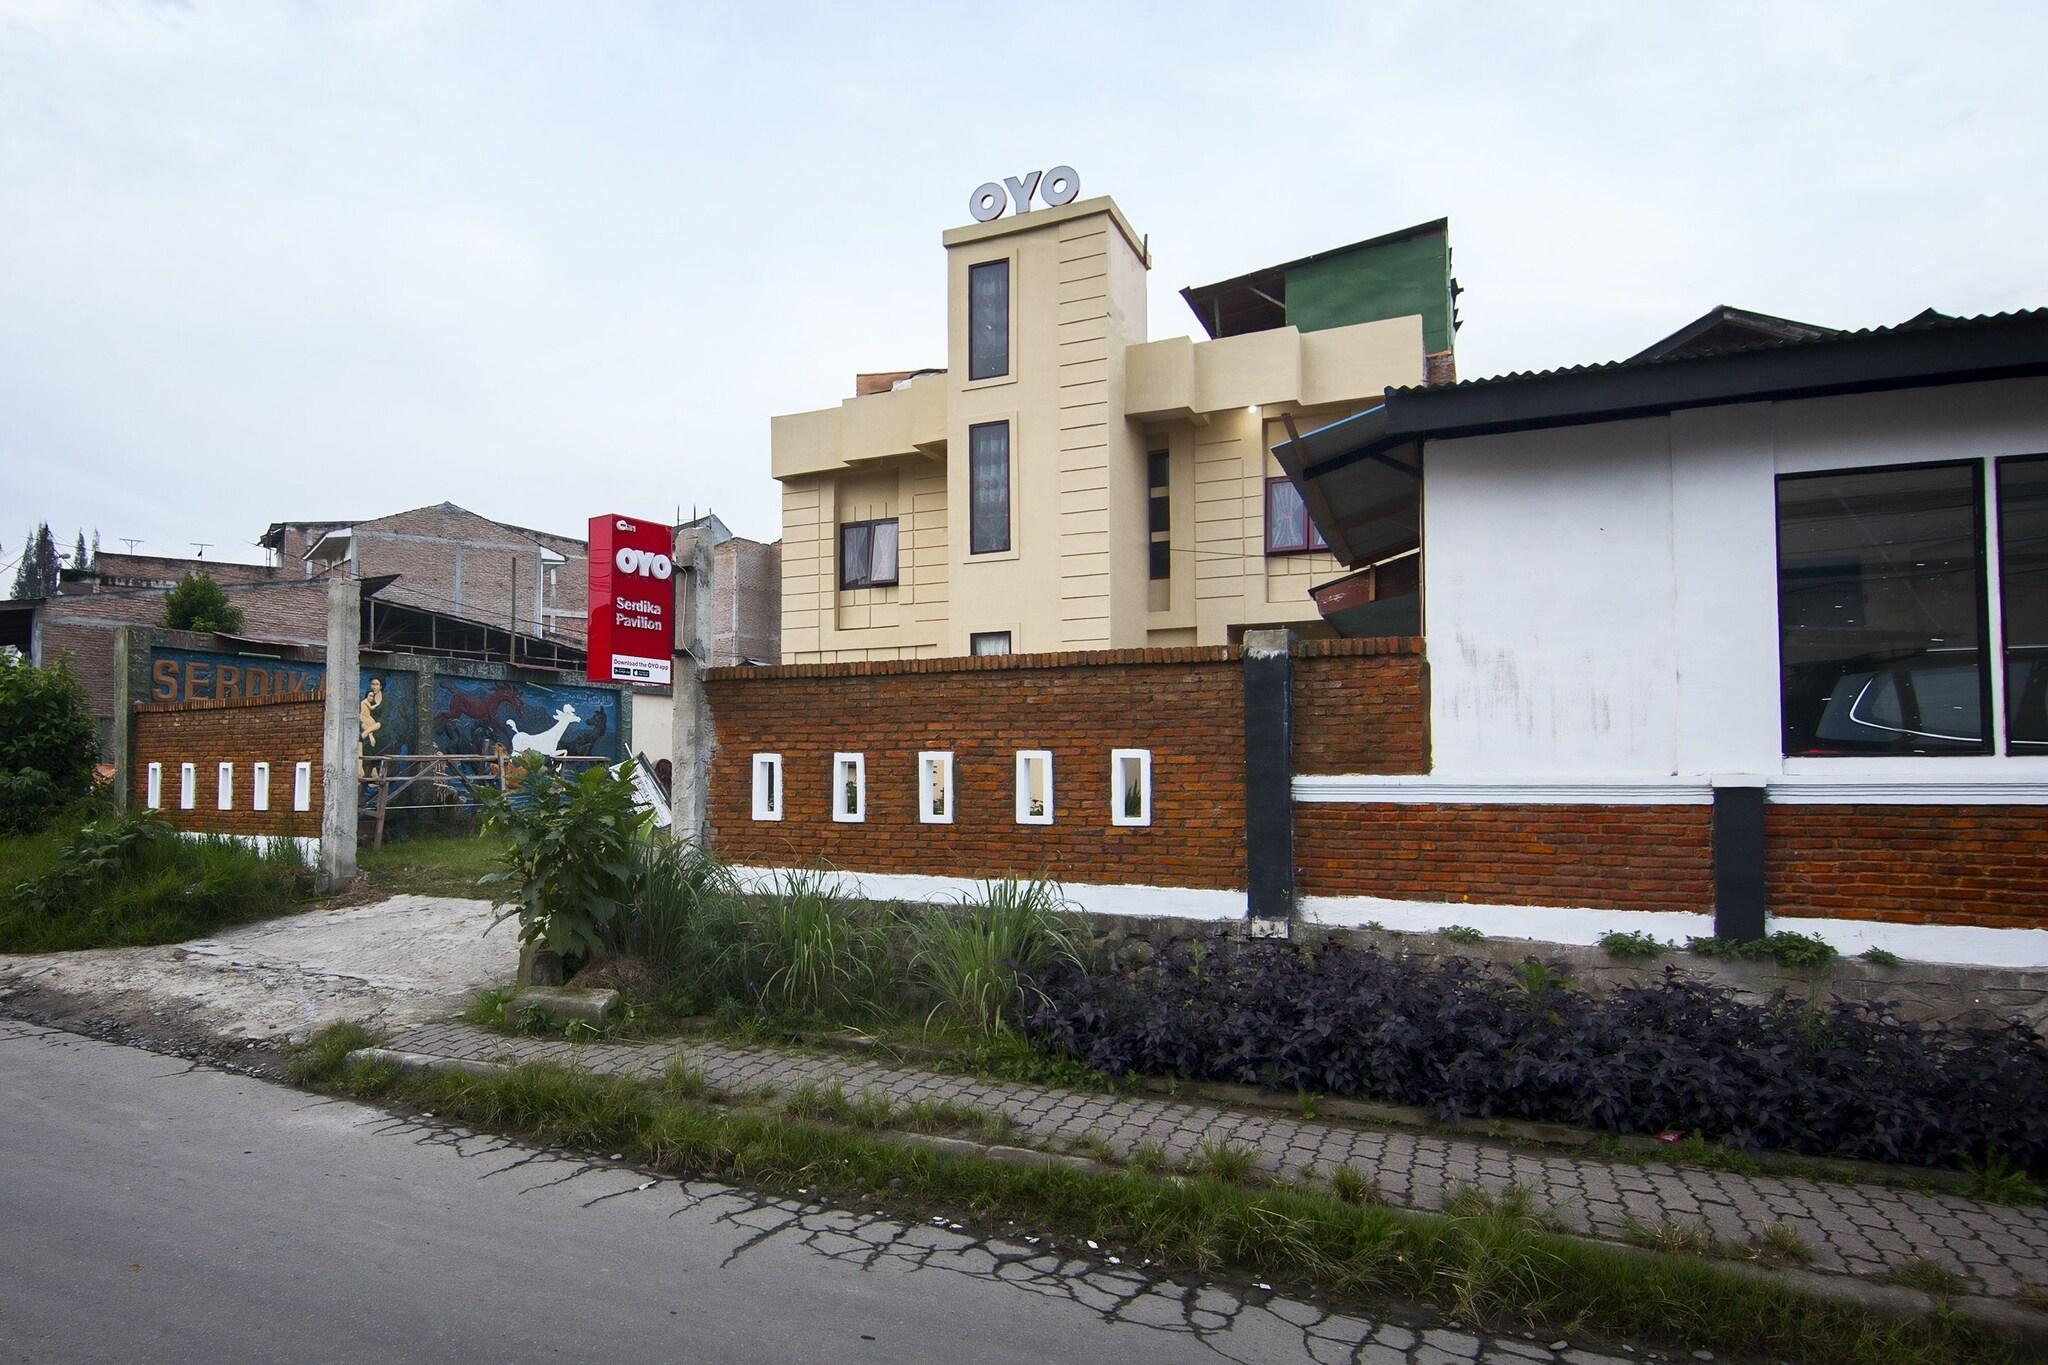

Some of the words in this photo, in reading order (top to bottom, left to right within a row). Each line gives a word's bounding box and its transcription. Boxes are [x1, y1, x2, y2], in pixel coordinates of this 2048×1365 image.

[969, 165, 1080, 222] OYO
[615, 547, 672, 580] OYO
[616, 597, 662, 615] Serdika
[616, 613, 662, 631] Pavilion
[614, 659, 638, 667] Download
[152, 659, 327, 703] SERDIK
